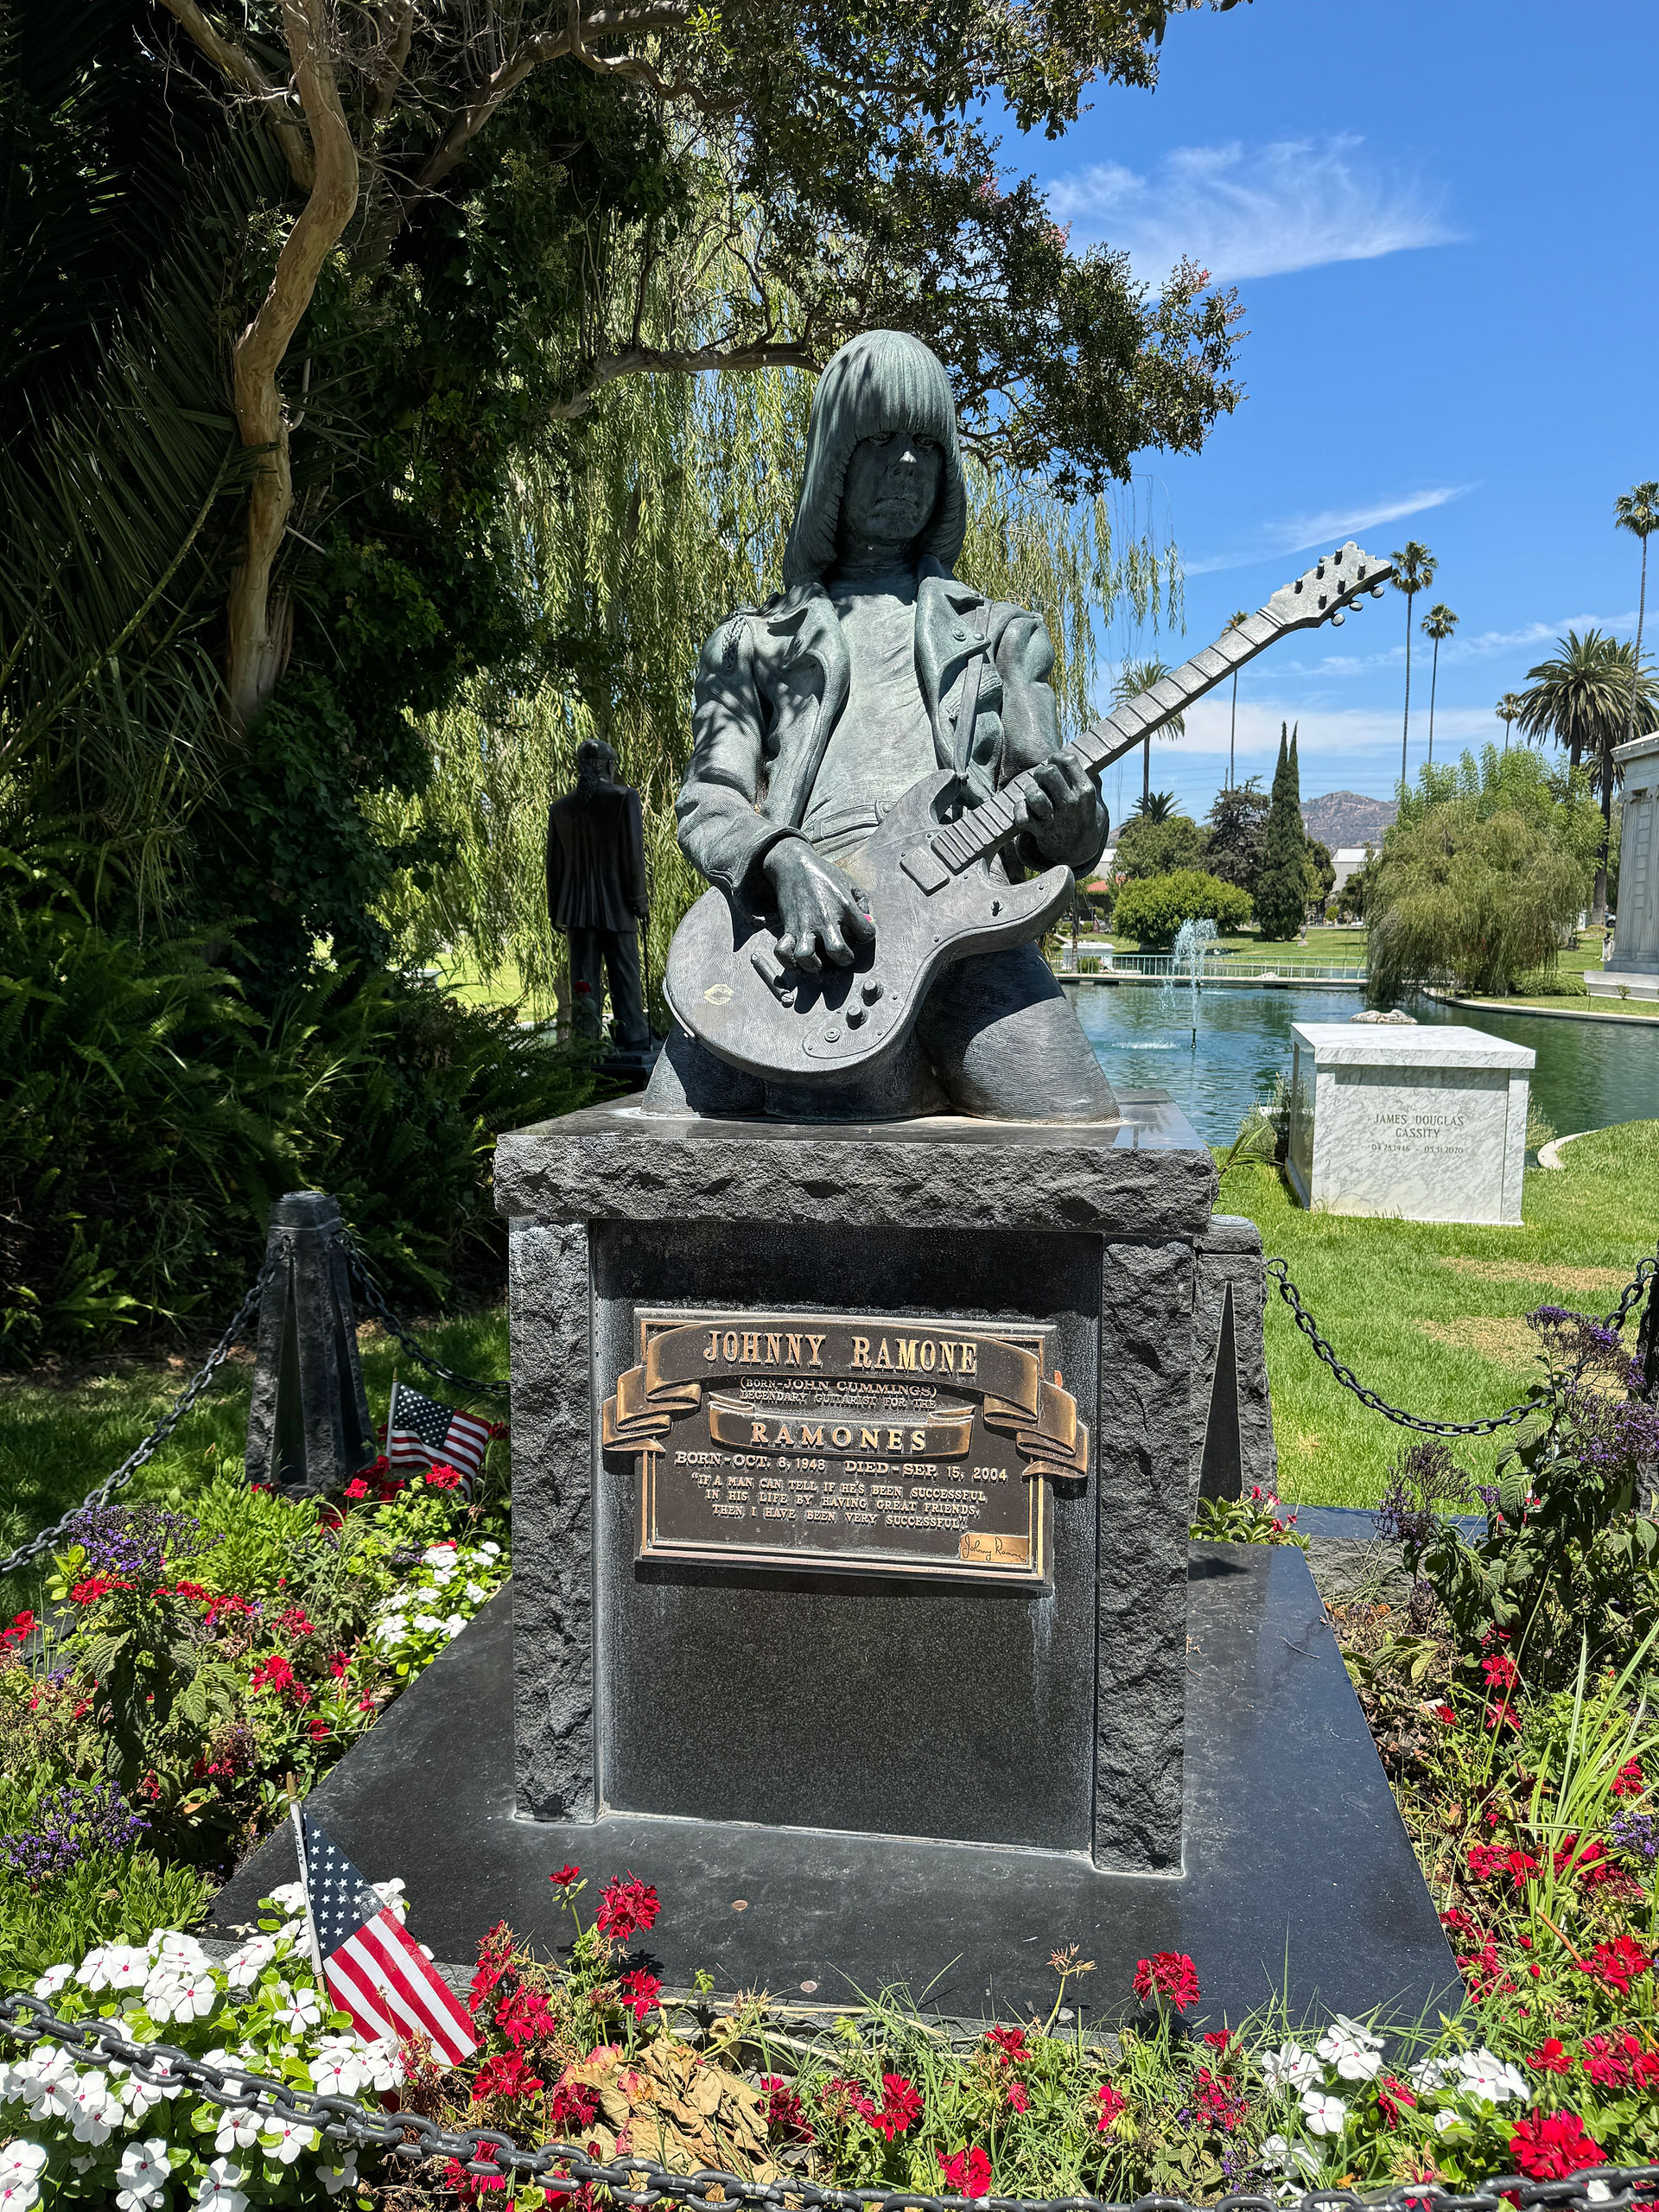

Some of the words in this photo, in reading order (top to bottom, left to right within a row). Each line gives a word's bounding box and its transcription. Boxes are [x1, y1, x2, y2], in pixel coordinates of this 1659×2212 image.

[1373, 1113, 1408, 1124] JAMES
[1415, 1115, 1465, 1127] DOUGLAS
[1395, 1127, 1440, 1139] CASSITY
[702, 1331, 827, 1367] JOHNNY
[849, 1337, 978, 1375] RAMONE
[740, 1389, 810, 1402] LEGENDARY
[814, 1393, 877, 1406] GUITARIST
[884, 1396, 906, 1408] FOR
[912, 1398, 937, 1409] THE
[836, 1381, 938, 1398] CUMMINGS)
[750, 1421, 926, 1452] RAMONES
[778, 1456, 791, 1471] 8,
[795, 1457, 826, 1471] 1948
[946, 1465, 965, 1479] 15,
[972, 1467, 1008, 1481] 2004
[705, 1489, 721, 1500] IN
[728, 1491, 749, 1502] HIS
[758, 1491, 788, 1504] LIFE
[795, 1494, 814, 1505] BY
[822, 1496, 868, 1510] HAVING
[875, 1499, 918, 1512] GREAT
[727, 1476, 754, 1487] MAN
[759, 1478, 784, 1490] CAN
[788, 1479, 819, 1491] TELL
[823, 1481, 836, 1492] IF
[841, 1481, 865, 1494] HE'S
[871, 1484, 903, 1497] BEEN
[910, 1487, 987, 1502] SUCCESSFUL
[711, 1503, 744, 1516] THEN
[750, 1506, 757, 1516] I
[765, 1507, 796, 1519] HAVE
[805, 1510, 836, 1522] BEEN
[844, 1512, 879, 1524] VERY
[962, 1535, 992, 1561] Johnny
